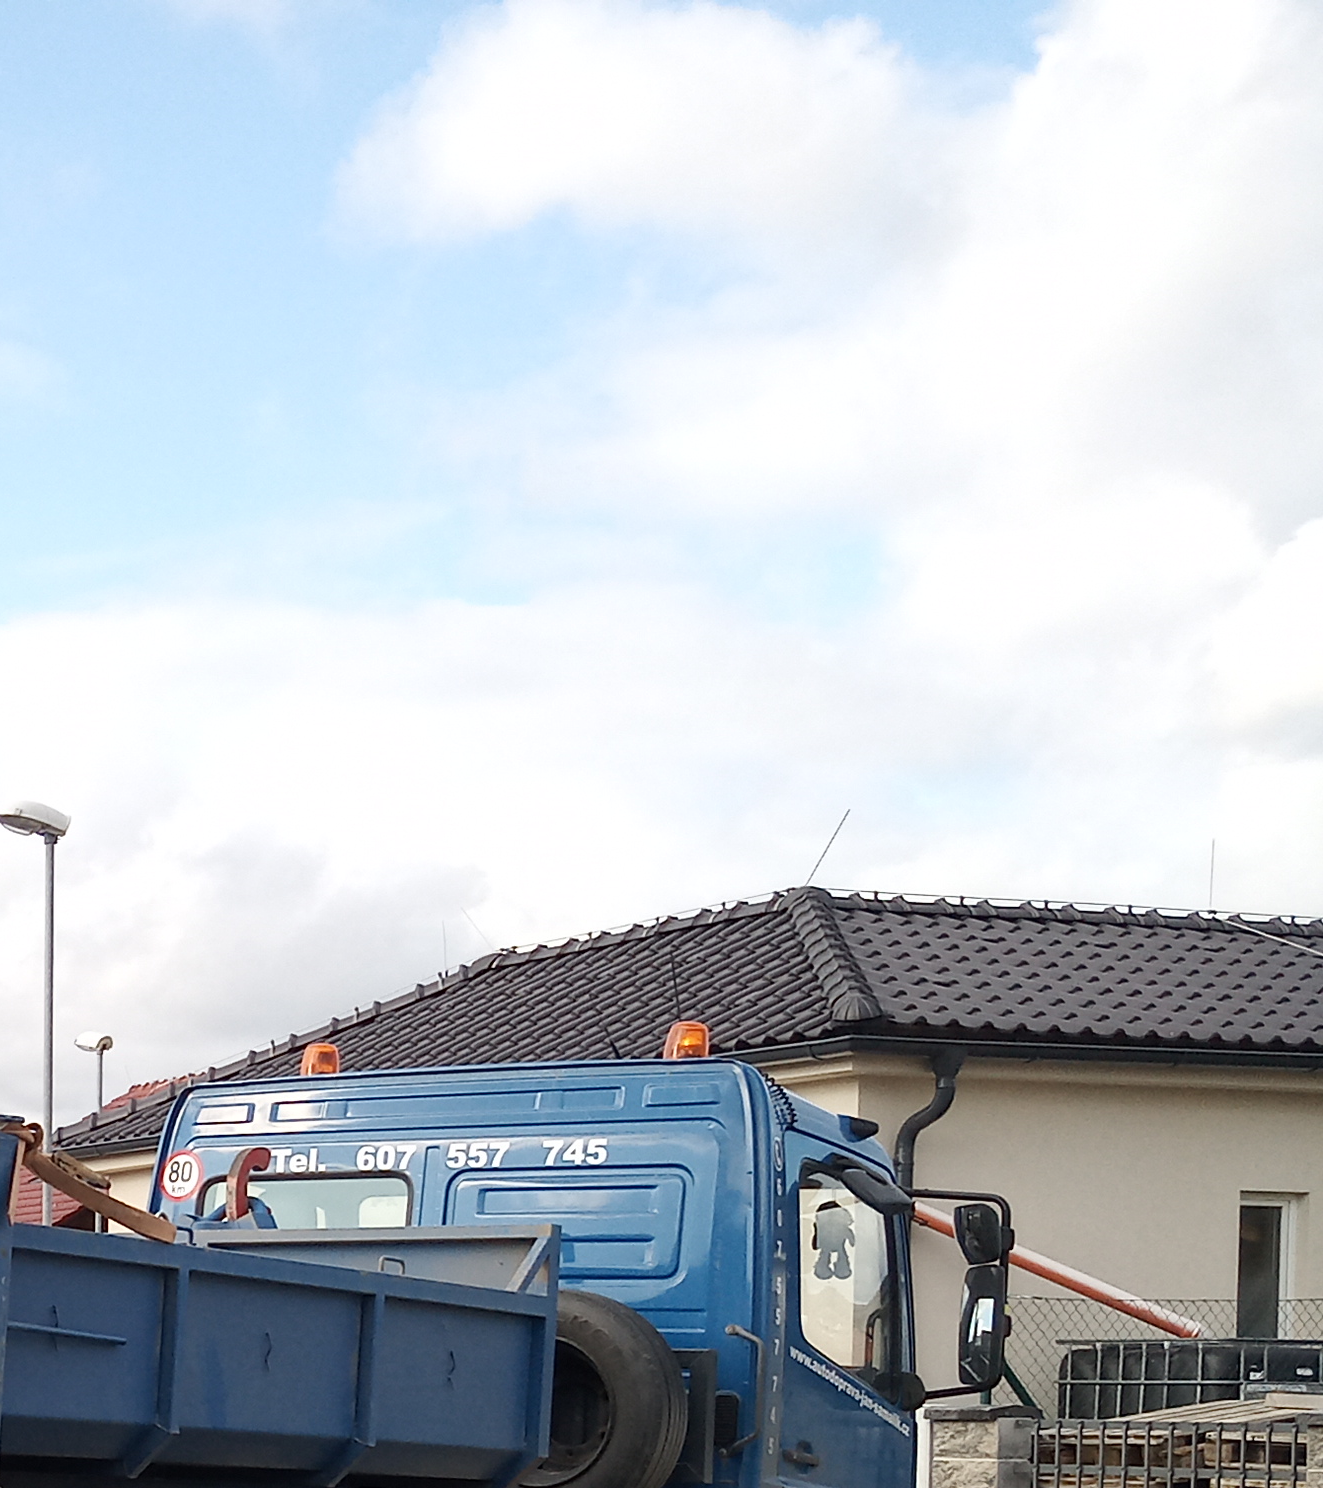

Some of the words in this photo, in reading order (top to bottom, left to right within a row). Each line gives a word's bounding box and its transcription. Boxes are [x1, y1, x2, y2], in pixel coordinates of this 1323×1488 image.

[270, 1147, 327, 1174] Tel.
[356, 1144, 417, 1172] 607
[445, 1140, 511, 1169] 557
[542, 1138, 608, 1167] 745
[168, 1160, 193, 1184] 80
[171, 1184, 186, 1194] km
